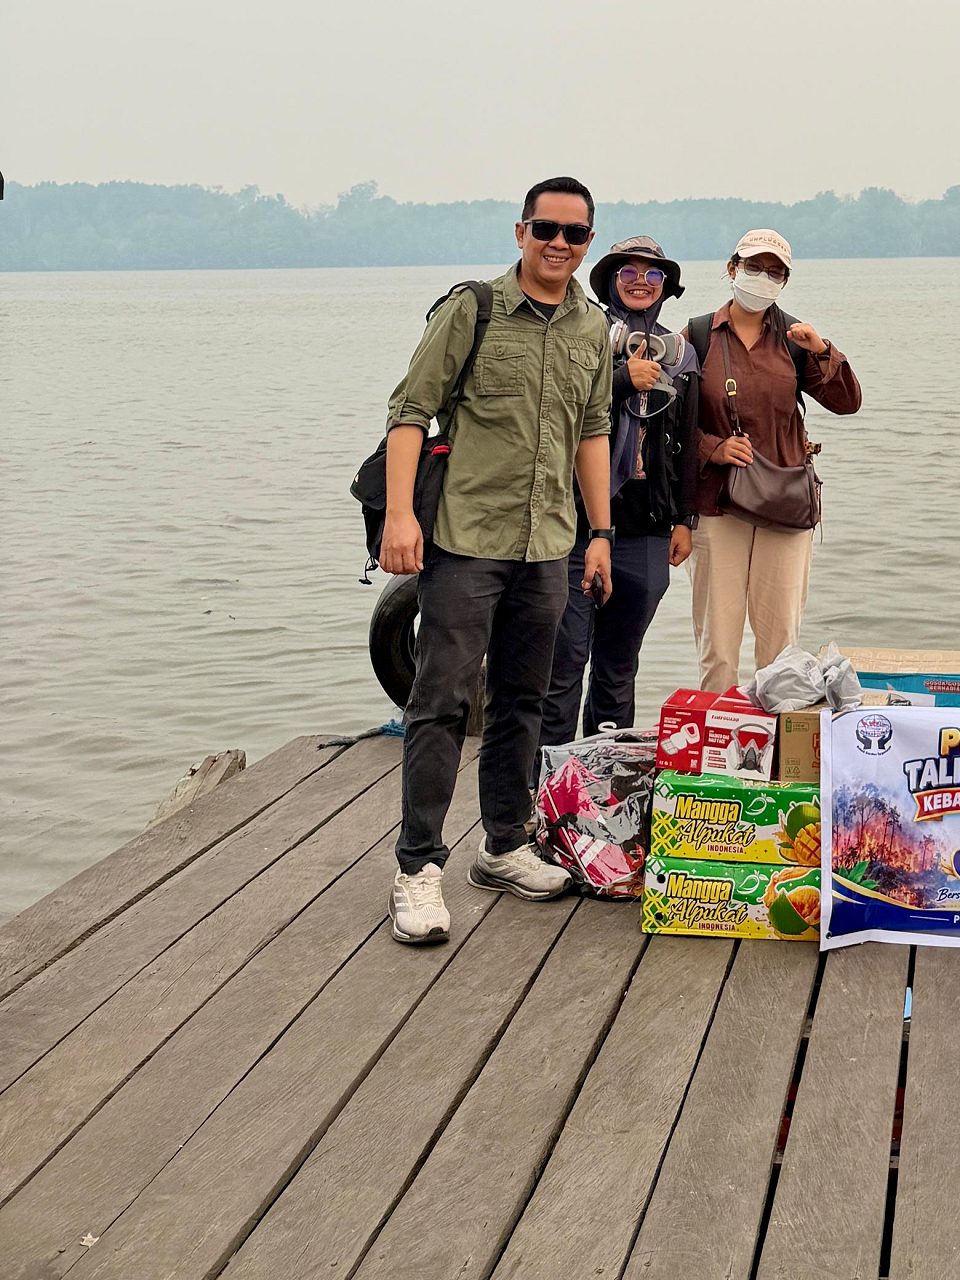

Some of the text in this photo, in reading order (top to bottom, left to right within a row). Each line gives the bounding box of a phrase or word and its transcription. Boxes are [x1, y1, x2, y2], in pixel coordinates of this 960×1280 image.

[674, 795, 740, 825] Mangga
[677, 819, 756, 850] Alpukat
[707, 844, 744, 853] INDONESIA
[666, 874, 732, 904] Mangga
[668, 898, 749, 929] Alpukat
[698, 922, 736, 931] INDONESIA
